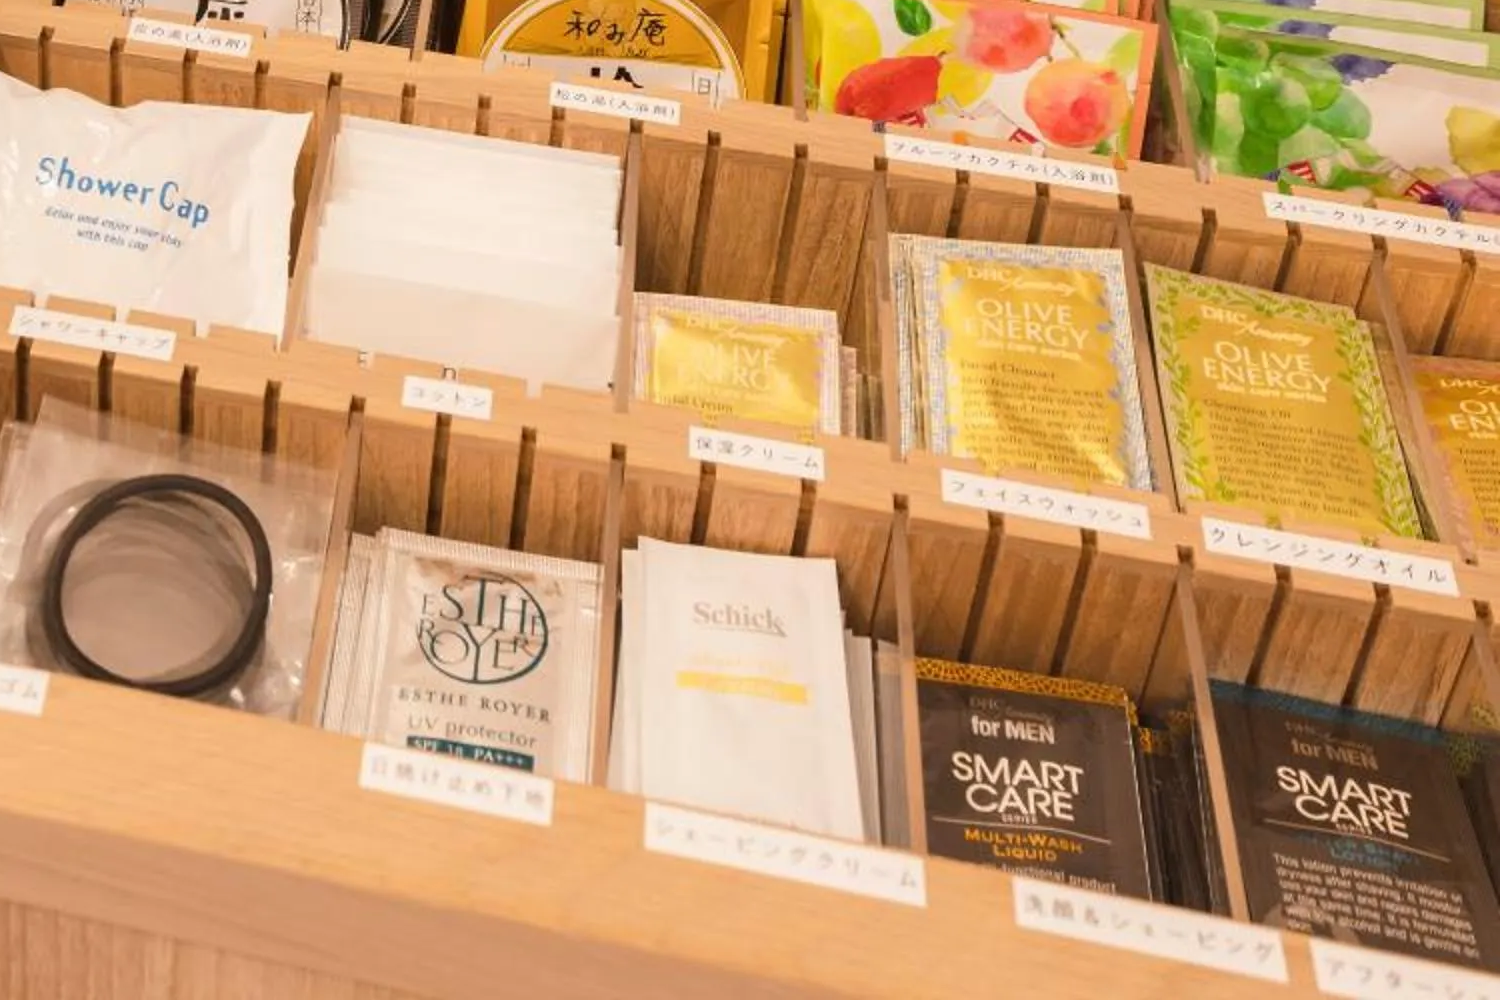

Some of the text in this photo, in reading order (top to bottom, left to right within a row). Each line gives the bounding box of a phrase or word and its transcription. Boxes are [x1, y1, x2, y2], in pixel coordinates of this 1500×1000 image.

[563, 7, 668, 46] 和み庵
[35, 156, 211, 228] Shower Cap
[976, 297, 1074, 327] OLIVE
[963, 316, 1090, 350] ENERGY
[1202, 356, 1333, 394] ENERGY
[1214, 340, 1315, 374] OLIVE
[691, 600, 788, 638] Schick
[398, 687, 552, 724] ESTHE ROYER
[406, 714, 538, 750] UV protector
[970, 714, 1056, 745] for MEN
[1291, 737, 1379, 771] for MEN
[951, 750, 1084, 796] SMART
[1276, 765, 1412, 817] SMART
[965, 782, 1075, 822] CARE
[1294, 795, 1410, 840] CARE
[992, 843, 1057, 862] LIQUID
